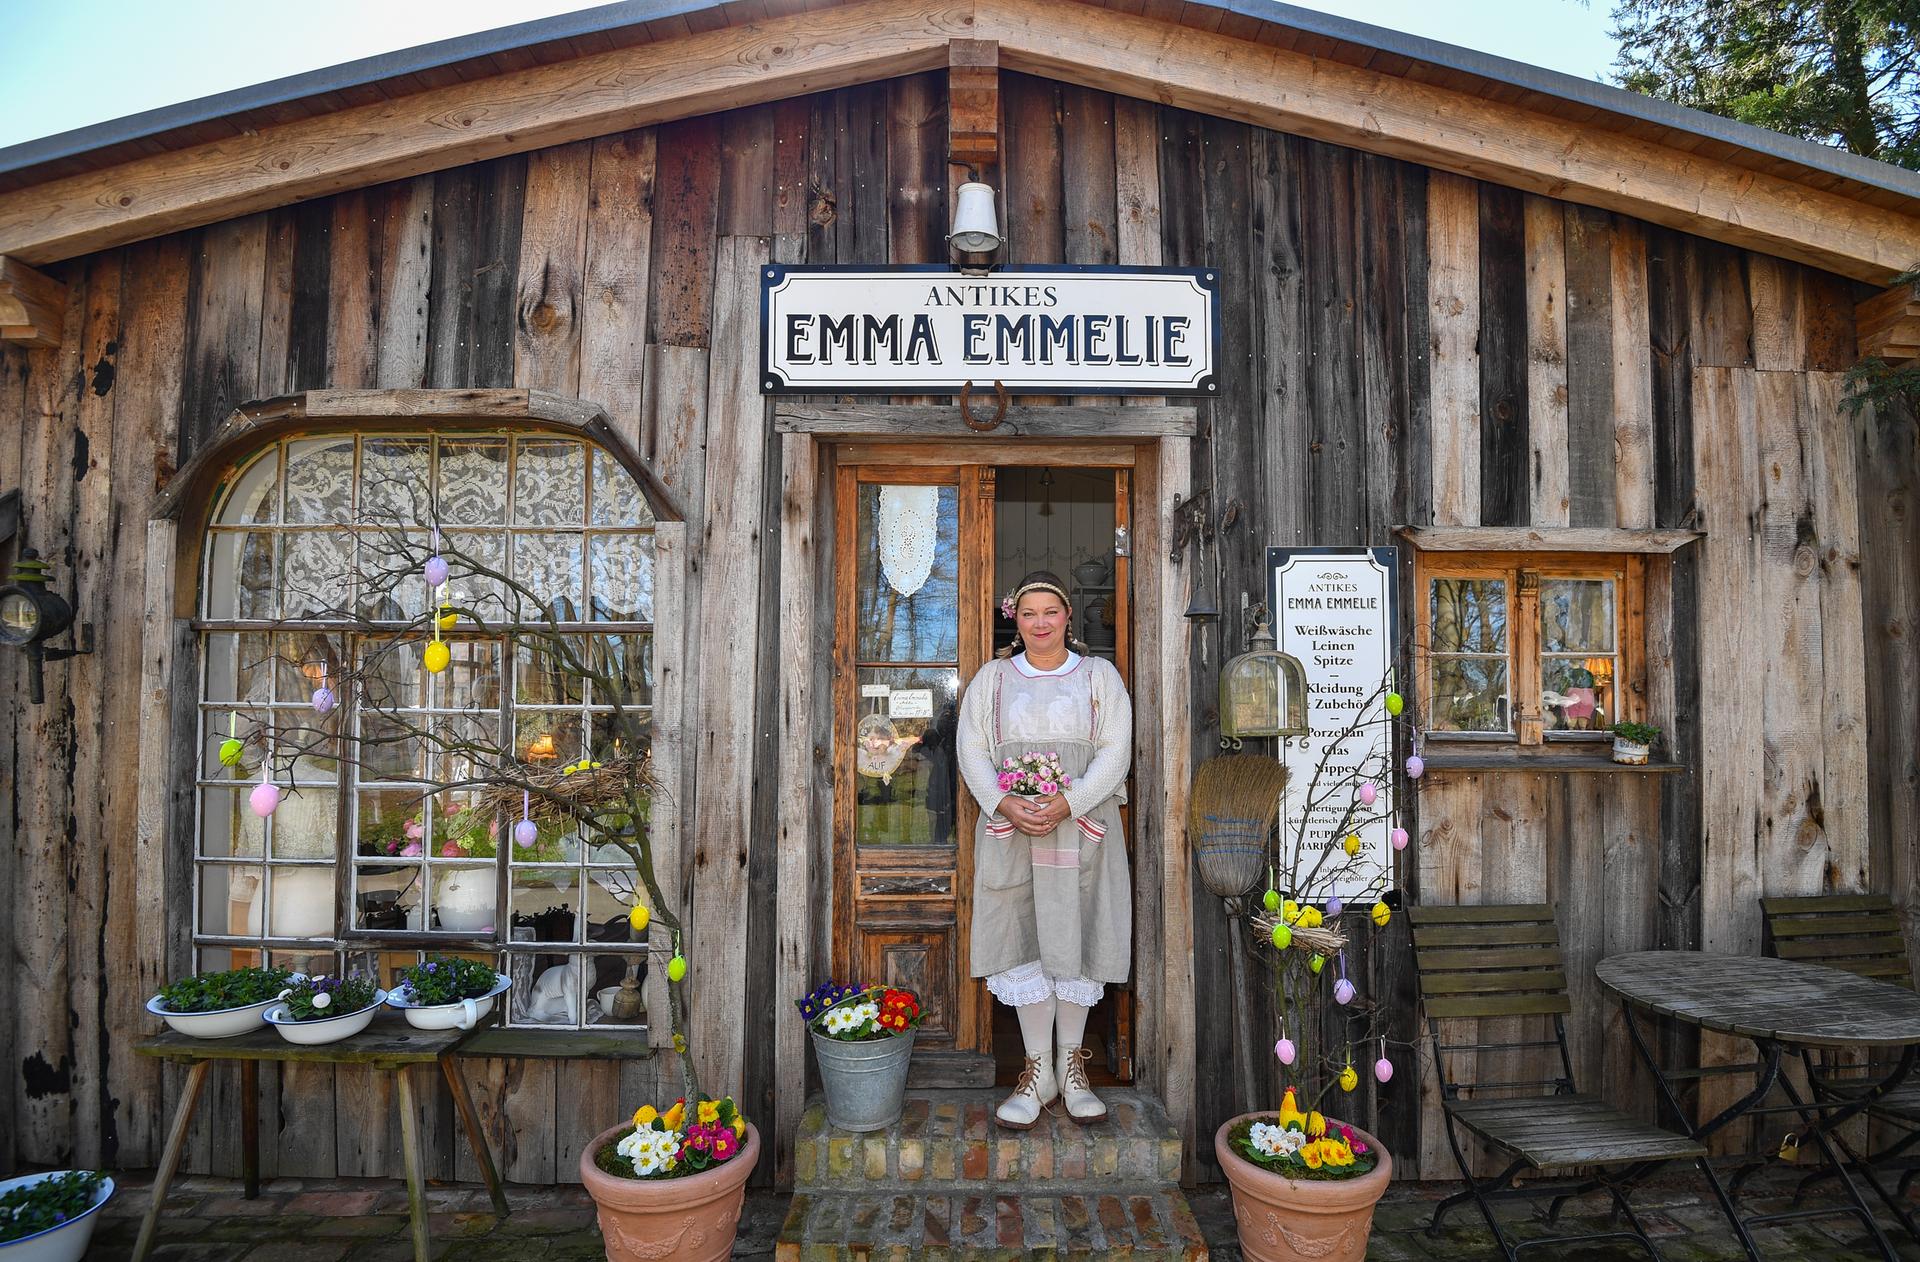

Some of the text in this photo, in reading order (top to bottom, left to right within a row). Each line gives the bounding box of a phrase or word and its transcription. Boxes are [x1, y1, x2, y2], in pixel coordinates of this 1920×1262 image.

[924, 285, 1058, 307] ANTIKES
[786, 313, 1193, 367] EMMA EMMELIE
[1308, 583, 1358, 592] ANTIKES
[1288, 597, 1378, 609] EMMA EMMELIE
[1295, 625, 1373, 636] Weißwäsche
[1312, 640, 1355, 651] Leinen
[1314, 655, 1354, 669] Spitze
[1307, 683, 1364, 697] Kleidung
[1315, 698, 1366, 710] Zubehö
[1307, 727, 1364, 738] Porzellan
[867, 761, 886, 770] AUF
[1300, 805, 1352, 815] Afertigun
[1289, 816, 1337, 824] küntlerisch
[1310, 830, 1350, 839] PUPPN
[1299, 842, 1376, 850] MARINEEN
